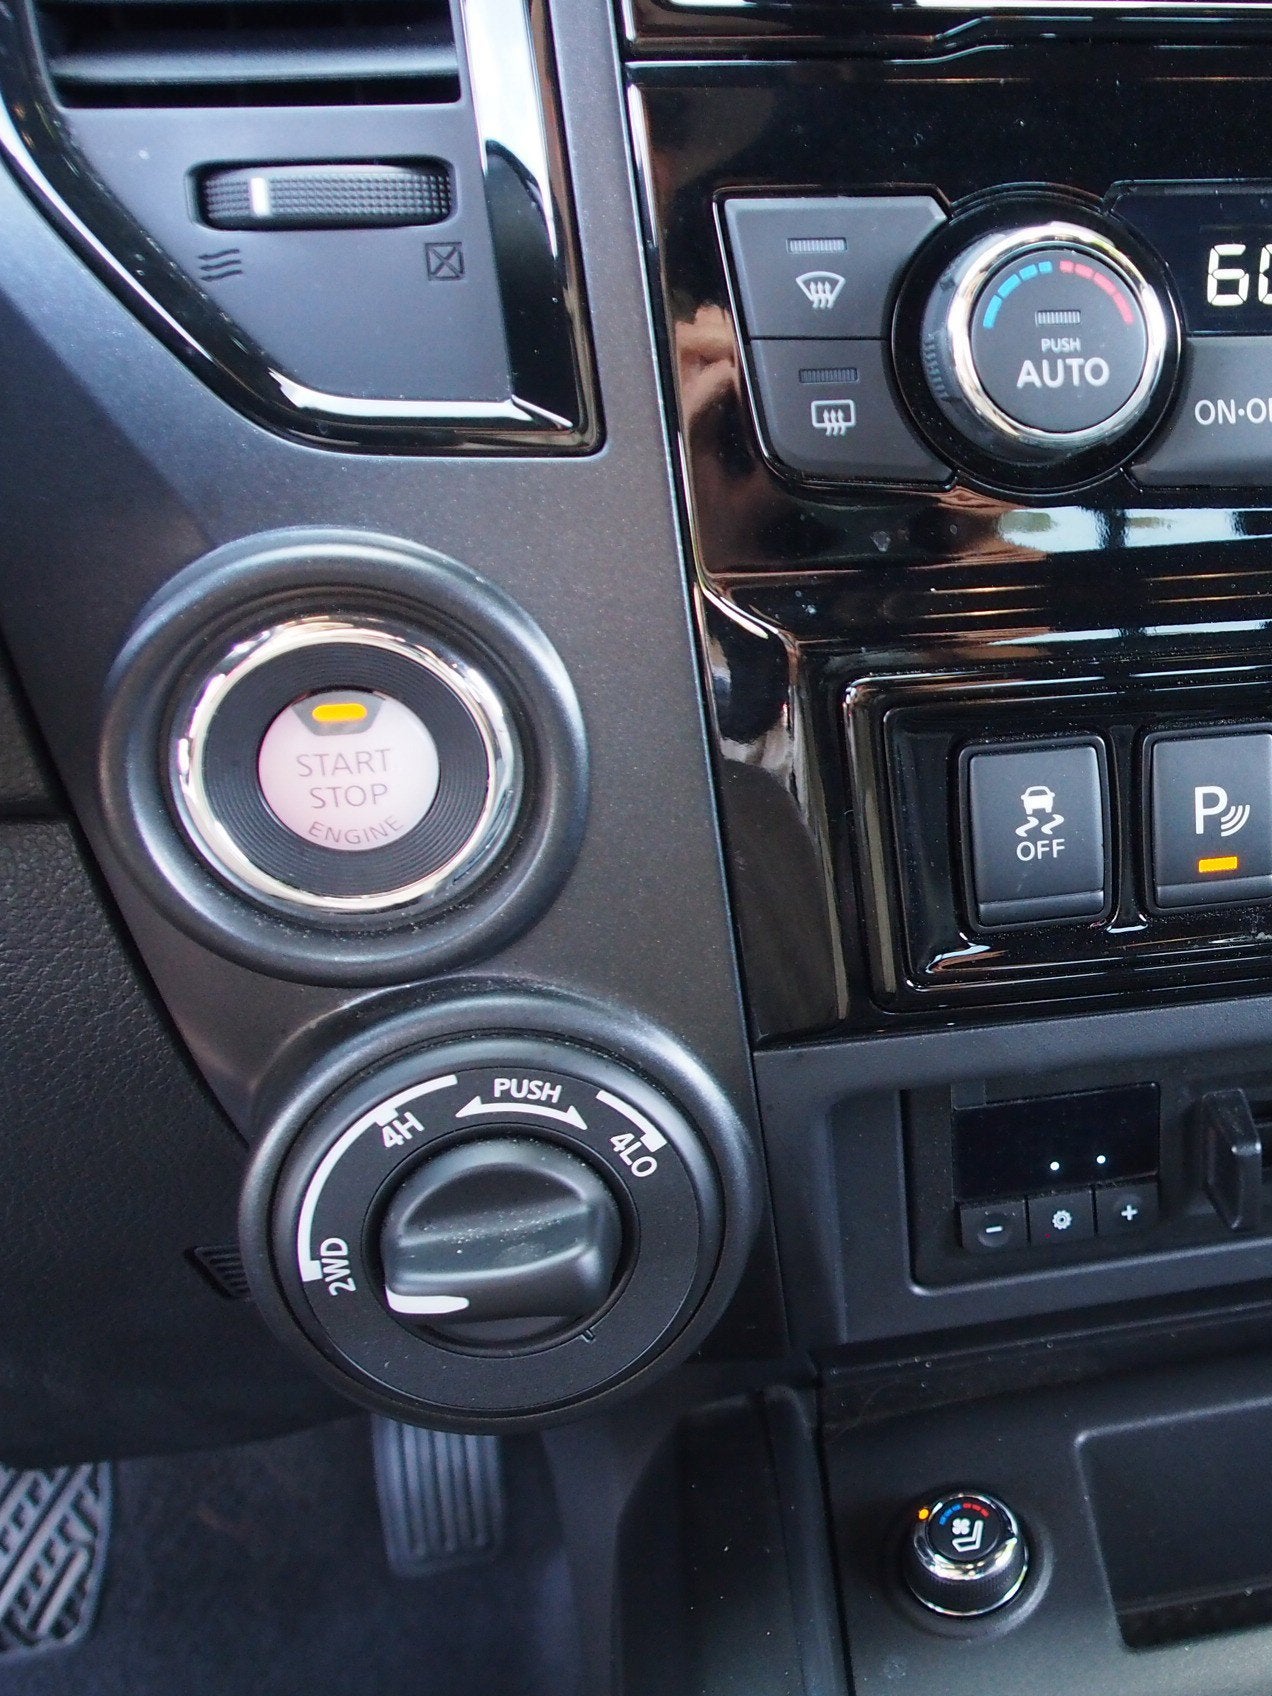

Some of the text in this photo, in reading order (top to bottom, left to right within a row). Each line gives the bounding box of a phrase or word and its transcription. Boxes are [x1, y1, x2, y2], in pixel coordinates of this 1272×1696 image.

[1040, 336, 1081, 353] PUSH
[1016, 357, 1110, 389] AUTO
[296, 748, 392, 778] START
[309, 783, 389, 809] STOP
[1194, 785, 1228, 836] P
[308, 814, 405, 845] ENGINE
[1016, 838, 1066, 862] OFF
[493, 1077, 562, 1104] PUSH
[378, 1110, 426, 1151] 4H
[609, 1131, 659, 1178] 4LO
[319, 1236, 357, 1297] 2WD
